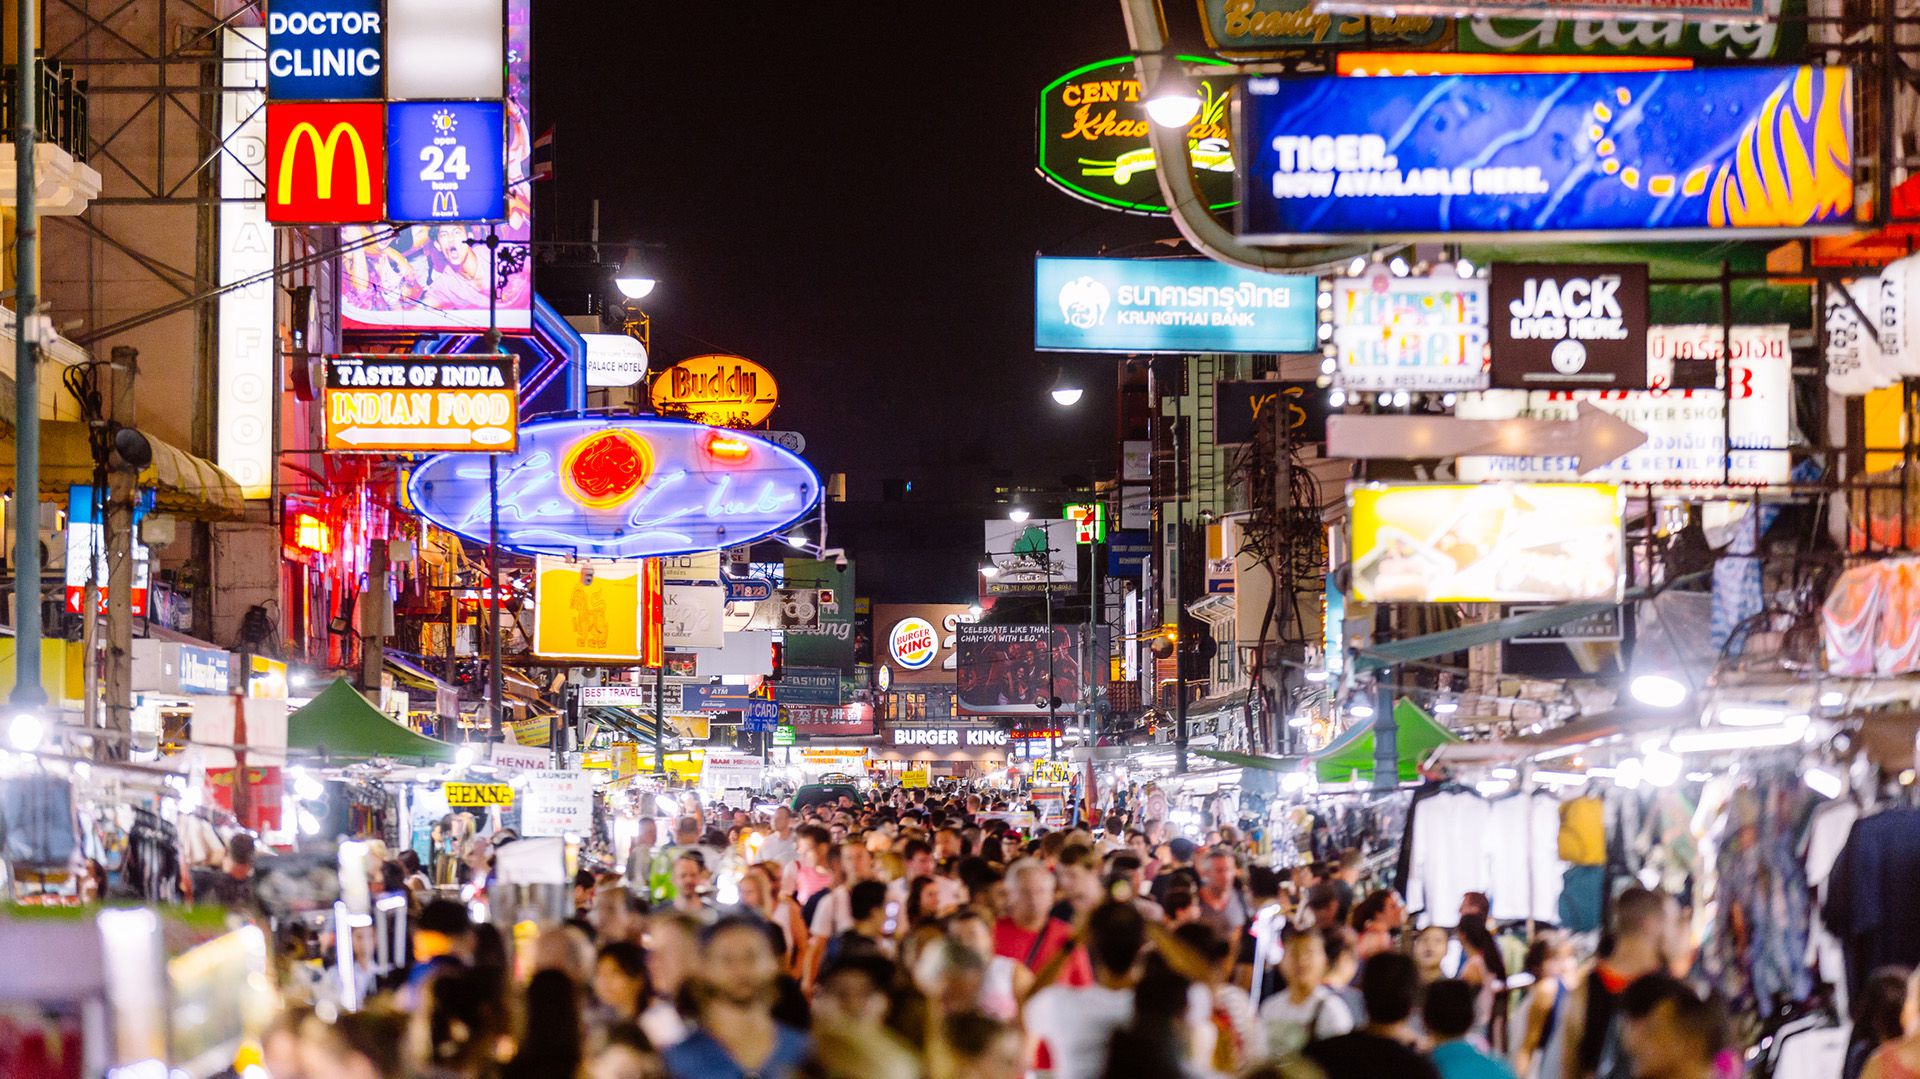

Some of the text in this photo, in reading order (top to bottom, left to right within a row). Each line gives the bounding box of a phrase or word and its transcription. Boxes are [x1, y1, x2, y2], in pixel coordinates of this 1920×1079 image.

[270, 12, 380, 35] DOCTOR
[269, 47, 381, 77] CLINIC
[1062, 80, 1142, 107] CENT
[419, 145, 471, 181] 24
[1272, 134, 1399, 173] TIGER.
[1272, 171, 1335, 198] NOW
[1117, 281, 1291, 313] ธนาคารกรุงไทย
[1508, 277, 1622, 319] JACK
[1117, 311, 1256, 327] KRUNGTHAI BANK
[337, 366, 505, 388] TASTE OF INDIA
[588, 361, 643, 373] PALACE HOTEL
[672, 366, 757, 403] Buddy
[332, 392, 511, 426] INDIAN FOOD
[732, 584, 768, 597] Plaza
[896, 629, 931, 646] BURGER
[898, 636, 932, 657] KING
[786, 677, 836, 687] FASHION
[585, 688, 606, 698] BEST
[609, 688, 641, 697] TRAVEL
[701, 700, 726, 708] Exchange
[755, 703, 777, 718] CARD
[894, 729, 959, 746] BURGER
[966, 730, 1008, 746] KING
[496, 756, 545, 770] HENNA
